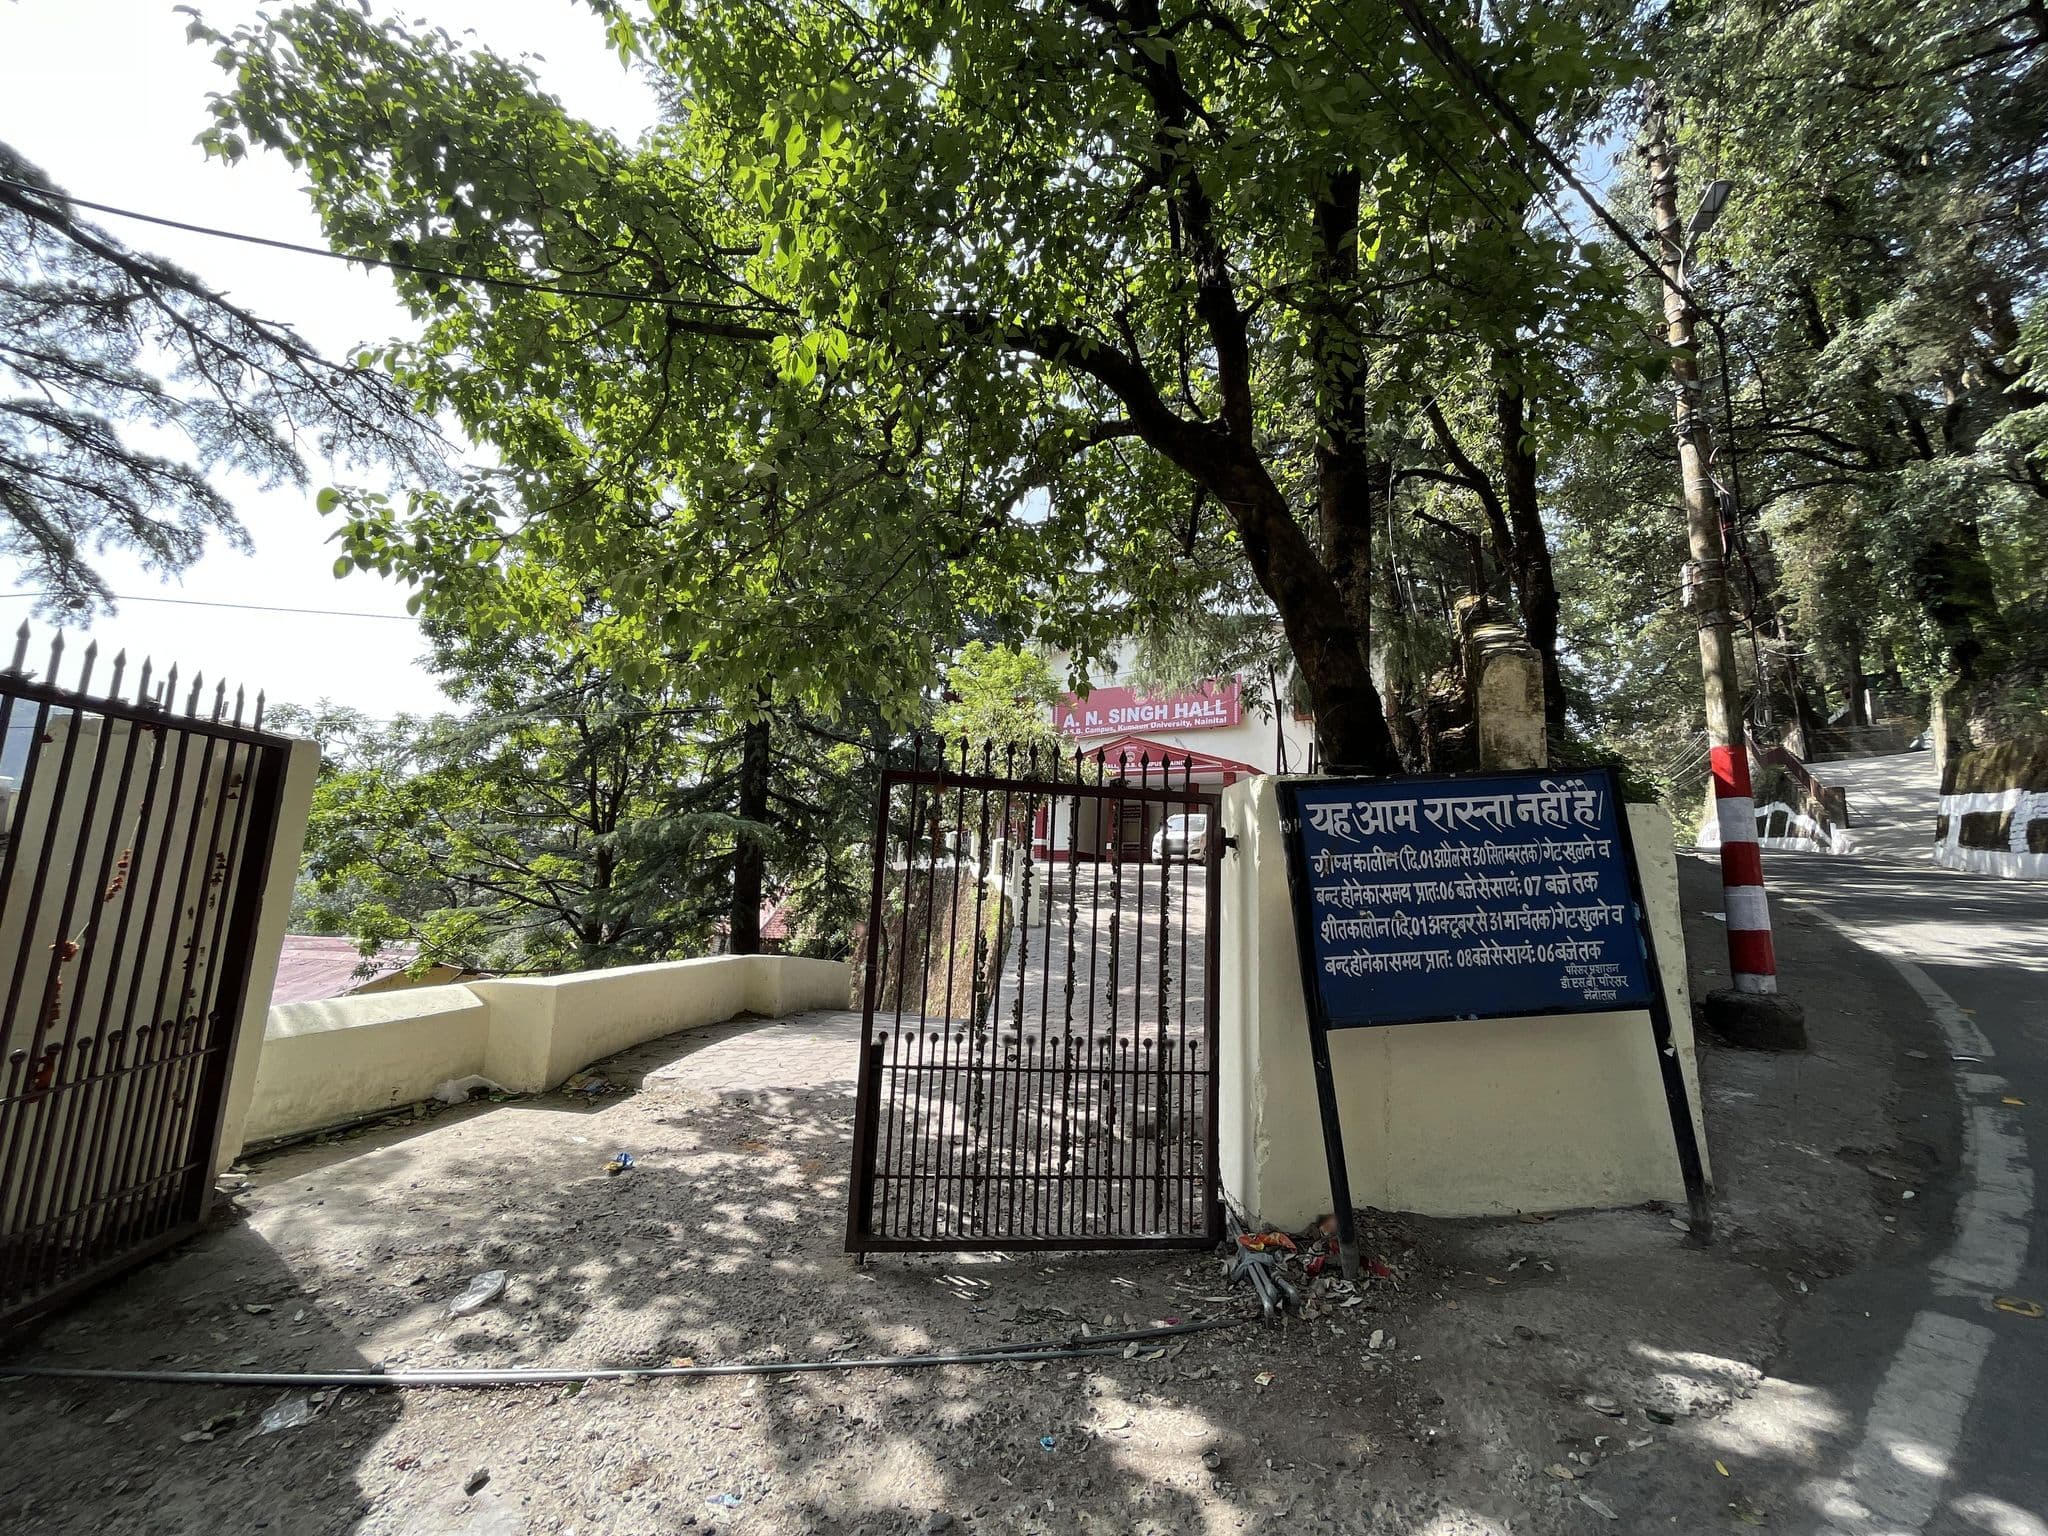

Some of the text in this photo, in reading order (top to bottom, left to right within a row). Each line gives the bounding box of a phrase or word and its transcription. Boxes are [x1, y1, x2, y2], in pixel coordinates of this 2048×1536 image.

[1063, 699, 1227, 729] A. N. SINGH HALL
[1194, 716, 1227, 726] Nainital
[1305, 802, 1360, 843] यह
[1352, 800, 1420, 835] आम
[1422, 794, 1516, 834] रास्ता
[1516, 779, 1573, 830] नहीं
[1541, 836, 1563, 862] गेट
[1561, 833, 1596, 864] खुलने
[1596, 839, 1612, 859] व
[1314, 886, 1342, 908] बन्द
[1379, 882, 1412, 905] समय
[1454, 872, 1478, 900] बजे
[1523, 875, 1542, 897] 07
[1543, 866, 1572, 895] बजे
[1571, 871, 1600, 895] तक
[1554, 901, 1578, 929] गेट
[1577, 898, 1611, 932] खुलने
[1610, 904, 1625, 925] व
[1388, 952, 1424, 973] समय
[1457, 949, 1474, 968] 08
[1536, 943, 1555, 963] 06
[1554, 935, 1579, 962] बजे
[1577, 940, 1606, 963] तक
